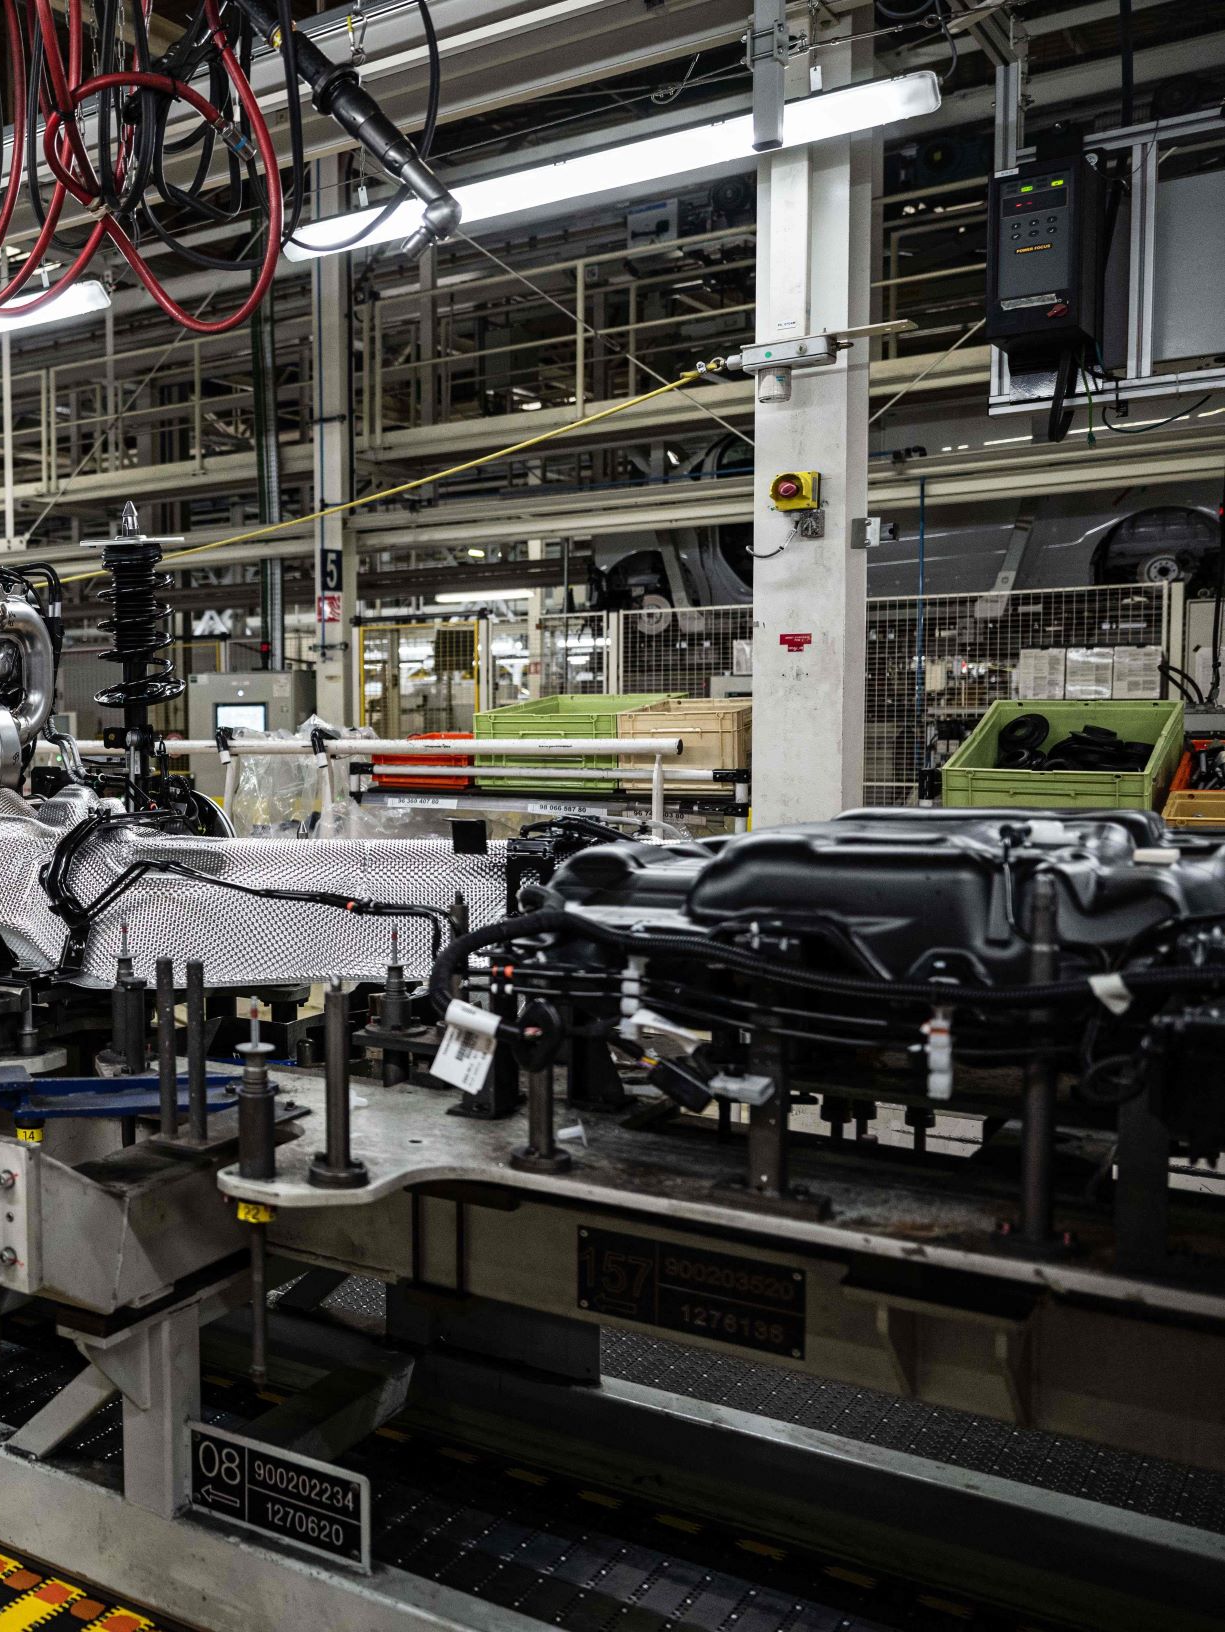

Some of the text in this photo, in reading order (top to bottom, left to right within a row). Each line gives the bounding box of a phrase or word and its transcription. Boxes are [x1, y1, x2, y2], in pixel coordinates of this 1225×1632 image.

[326, 552, 337, 588] 5
[22, 1130, 35, 1141] 14
[579, 1246, 654, 1299] 157
[199, 1441, 241, 1485] 08
[254, 1460, 354, 1512] 900202234
[266, 1501, 344, 1546] 1270620
